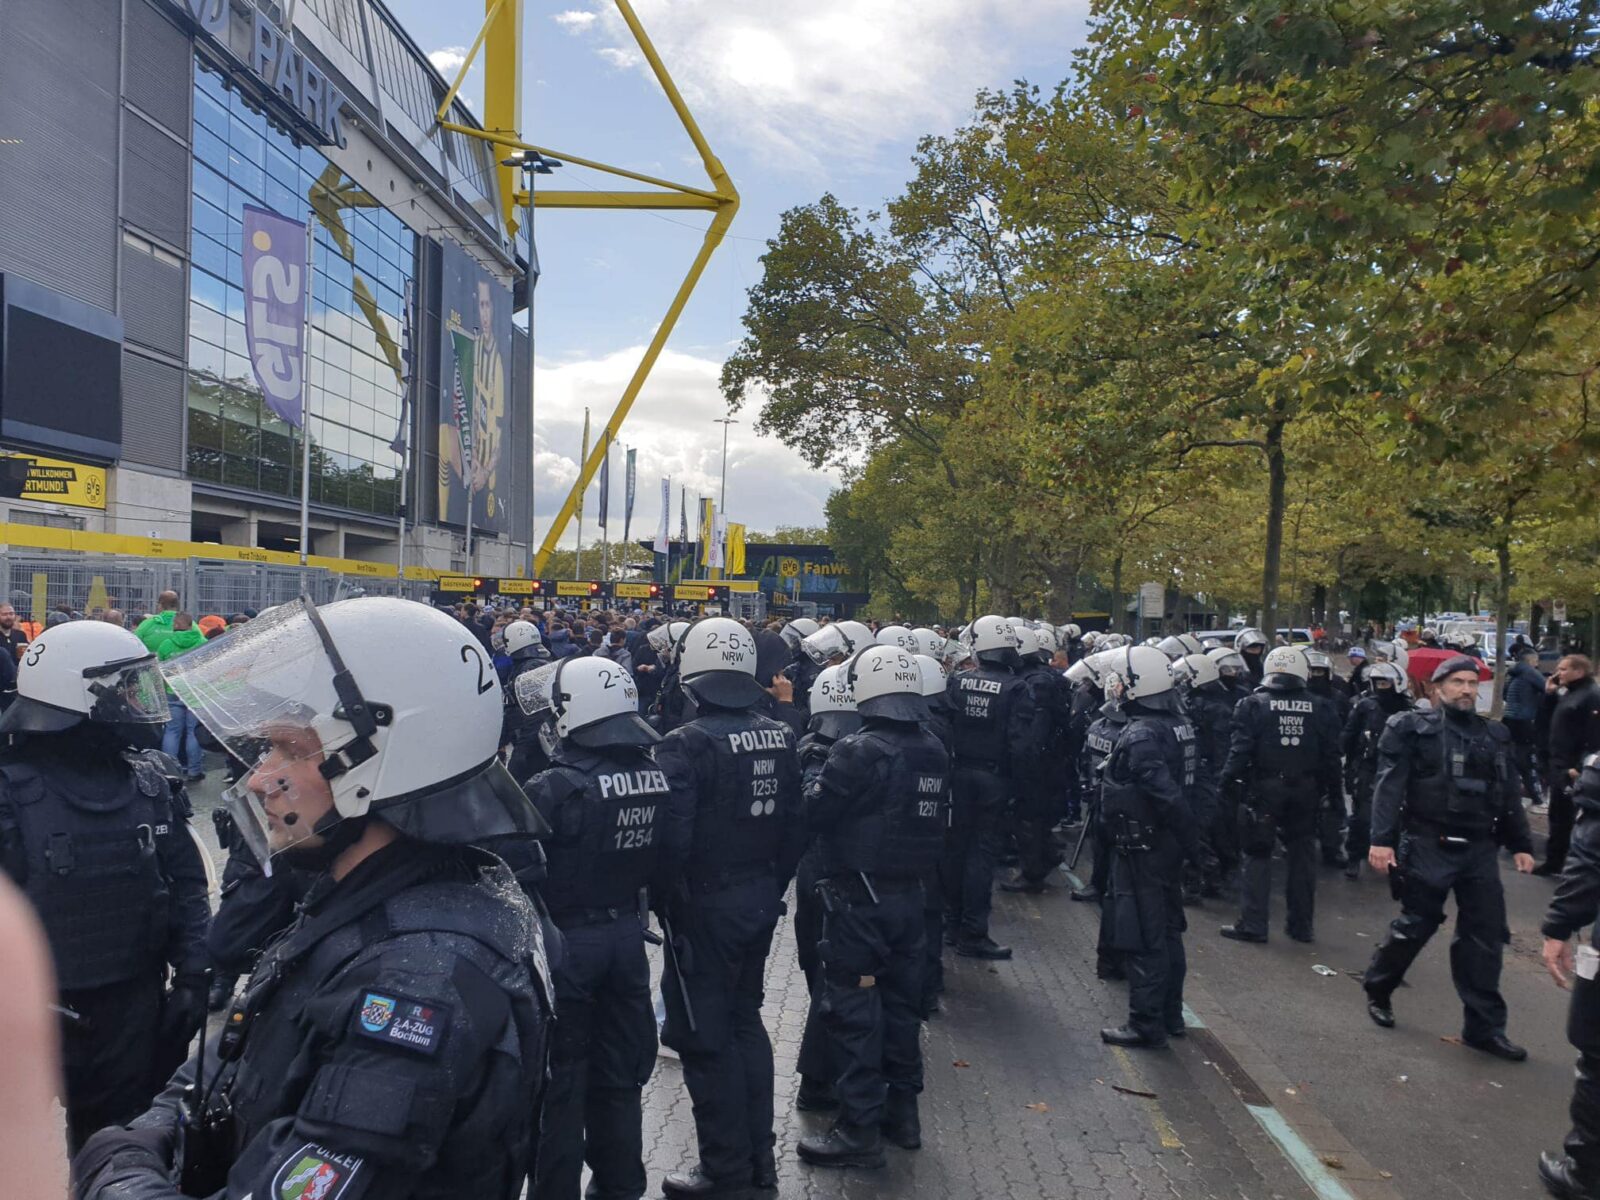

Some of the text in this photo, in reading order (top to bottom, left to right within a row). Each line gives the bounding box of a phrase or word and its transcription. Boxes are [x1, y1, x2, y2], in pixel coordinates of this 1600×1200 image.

[253, 7, 347, 150] PARK
[31, 467, 73, 479] WILLKOMMEN
[783, 560, 798, 571] BVB
[706, 632, 755, 655] 2-5-3
[721, 651, 744, 662] NRW
[894, 672, 917, 682] NRW
[960, 677, 1002, 694] POLIZEI
[829, 694, 853, 703] NRW
[967, 695, 990, 707] NRW
[1270, 700, 1313, 713] POLIZEI
[964, 706, 988, 718] 1554
[1279, 715, 1305, 726] NRW
[1277, 725, 1305, 736] 1553
[728, 729, 787, 753] POLIZEI
[753, 759, 776, 776] NRW
[598, 770, 670, 799] POLIZEI
[751, 777, 778, 797] 1253
[918, 776, 943, 793] NRW
[616, 805, 656, 827] NRW
[614, 827, 654, 849] 1254
[389, 1026, 431, 1046] Bochum
